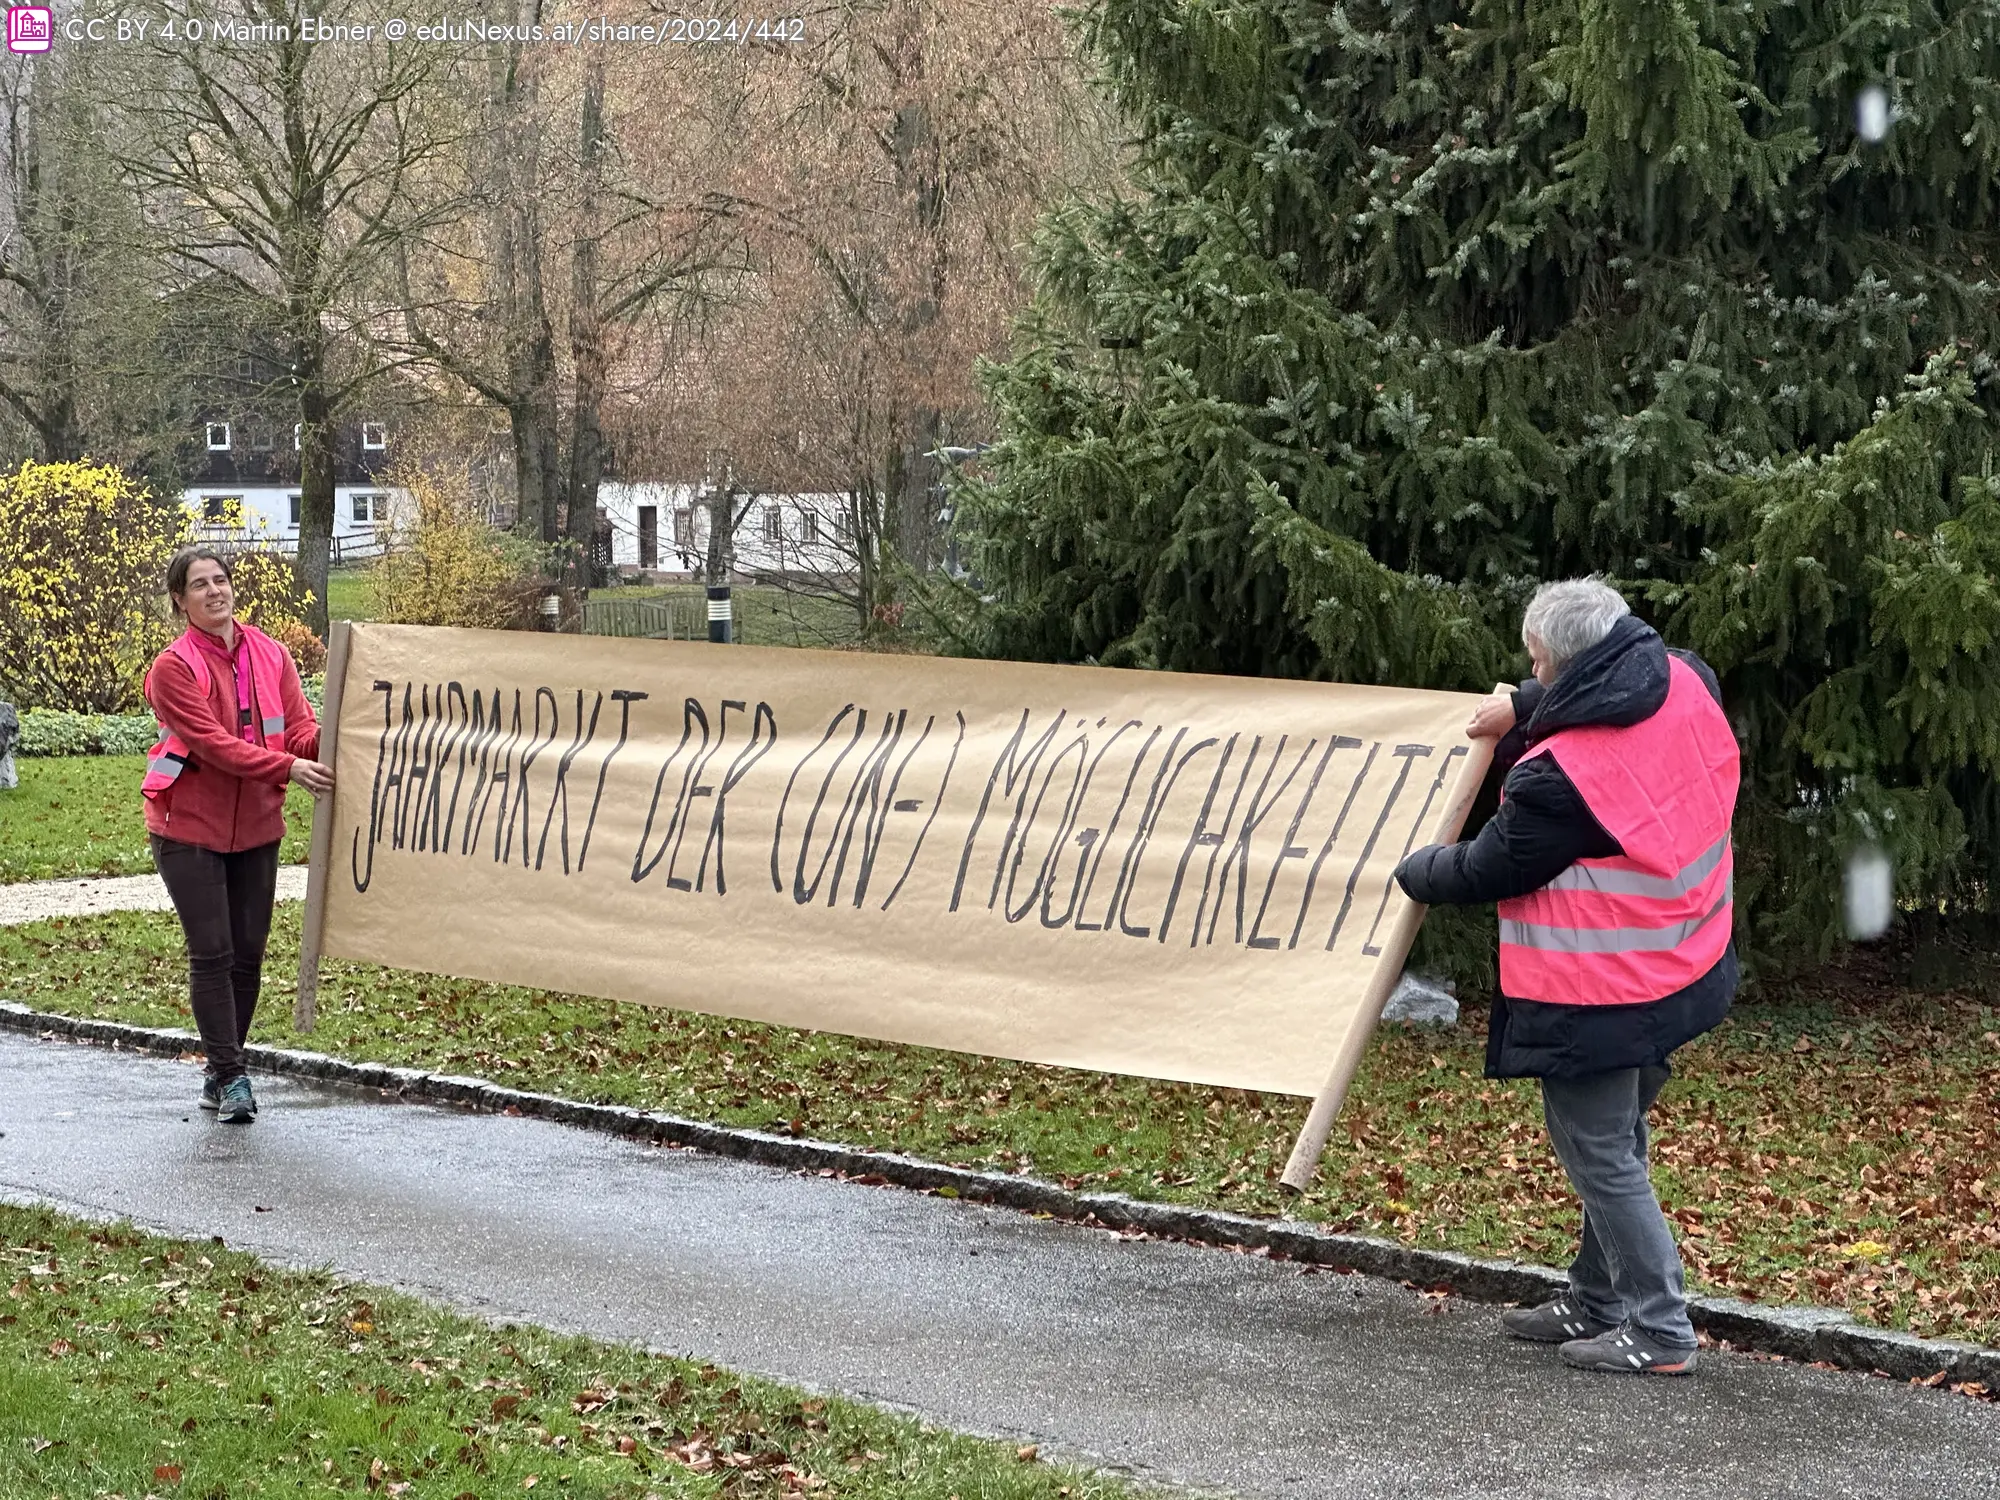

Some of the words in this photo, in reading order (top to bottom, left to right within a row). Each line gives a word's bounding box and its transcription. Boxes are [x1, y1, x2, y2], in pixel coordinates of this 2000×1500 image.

[353, 681, 650, 893] JAHRMARKT
[631, 697, 778, 896] DER
[770, 703, 967, 911] (UN-)
